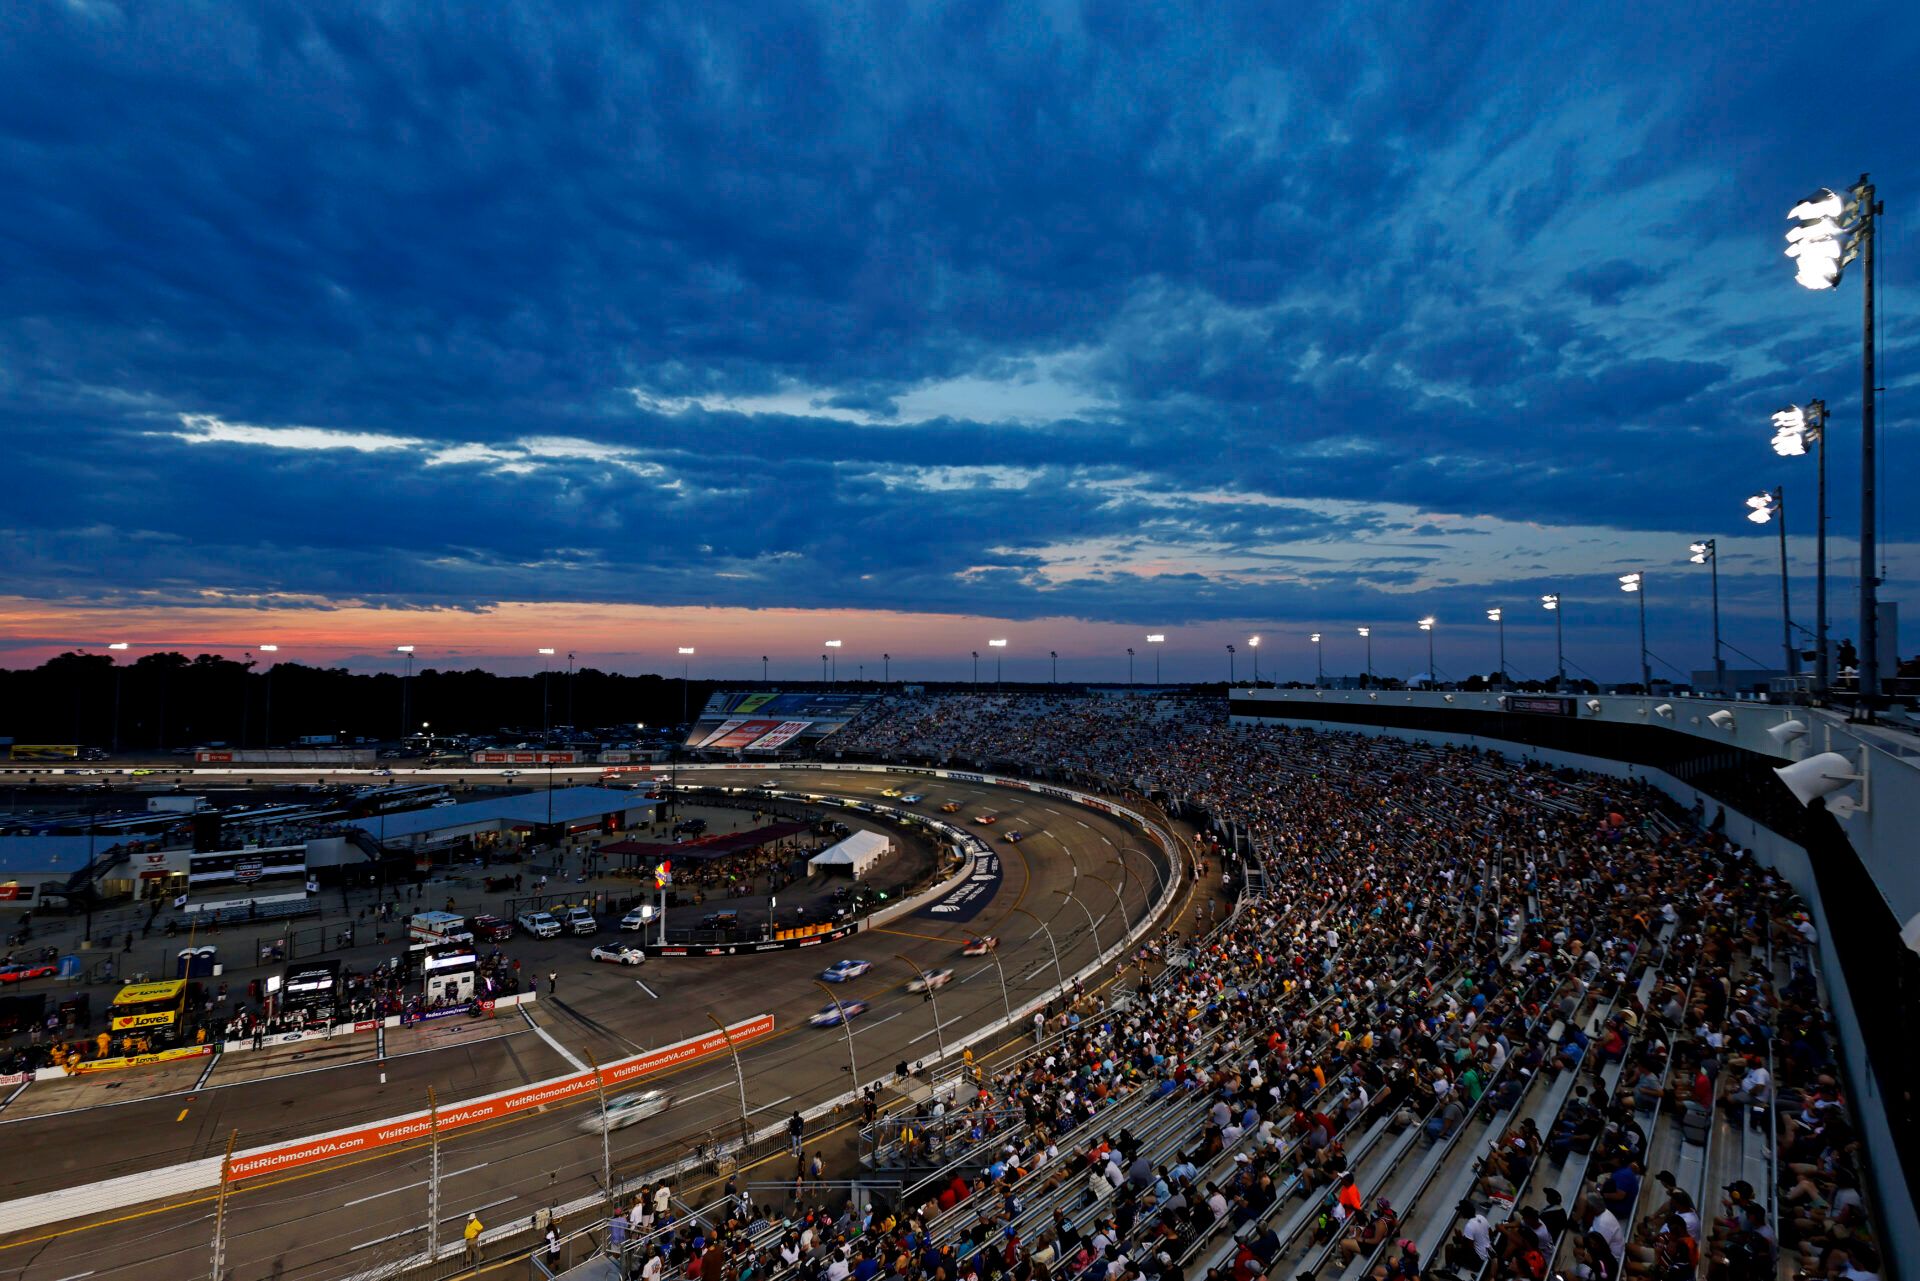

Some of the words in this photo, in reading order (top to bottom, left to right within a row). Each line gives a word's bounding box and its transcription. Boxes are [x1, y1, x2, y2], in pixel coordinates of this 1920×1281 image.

[135, 1013, 169, 1026] Love's
[702, 1022, 770, 1050] VisitRicmondVA.com
[613, 1047, 696, 1078] VisitRichmondVA.com
[231, 1138, 364, 1174] VisitRichmondVA.com
